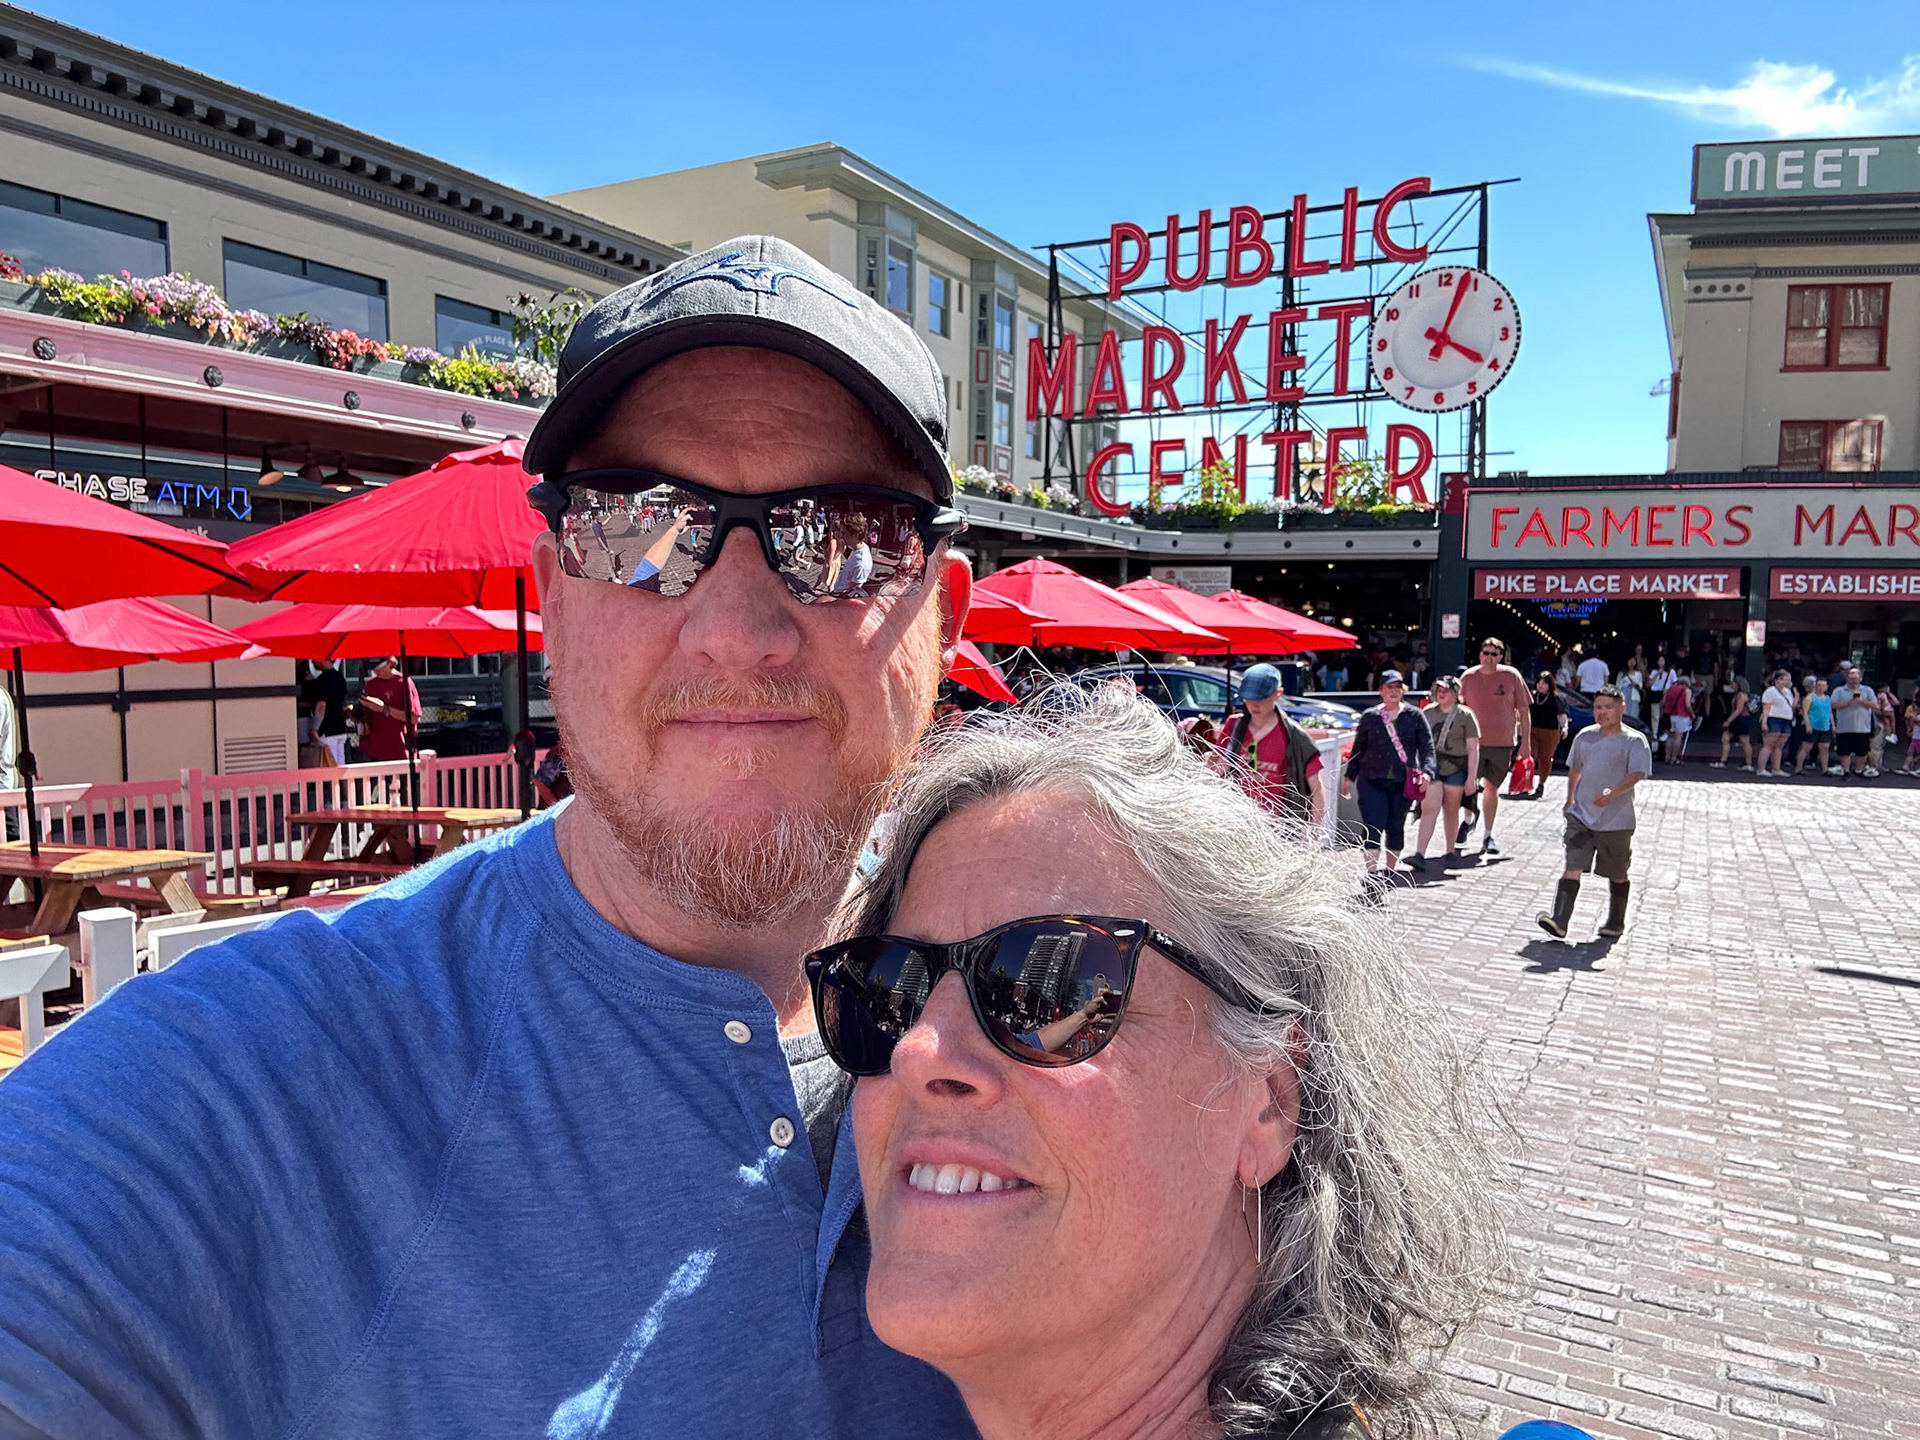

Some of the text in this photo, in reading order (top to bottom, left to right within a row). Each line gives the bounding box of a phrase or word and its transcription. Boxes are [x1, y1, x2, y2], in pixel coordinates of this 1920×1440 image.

[1724, 147, 1880, 192] MEET
[1109, 176, 1432, 301] PUBLIC
[1438, 273, 1453, 287] 12
[1473, 278, 1478, 292] 1
[1409, 284, 1420, 299] 11
[1493, 298, 1503, 311] 2
[1386, 308, 1399, 322] 10
[1500, 327, 1509, 341] 3
[1377, 339, 1388, 352] 9
[1026, 301, 1372, 422] MARKET
[1488, 358, 1500, 372] 4
[1383, 367, 1394, 380] 8
[1405, 386, 1415, 400] 7
[1466, 381, 1477, 395] 5
[1433, 392, 1444, 405] 6
[1086, 424, 1434, 517] CENTER
[156, 482, 220, 509] ATM
[1491, 504, 1920, 547] FARMERS MAR
[1485, 574, 1729, 593] PIKE PLACE MARKET
[1780, 574, 1920, 594] ESTABLISHE
